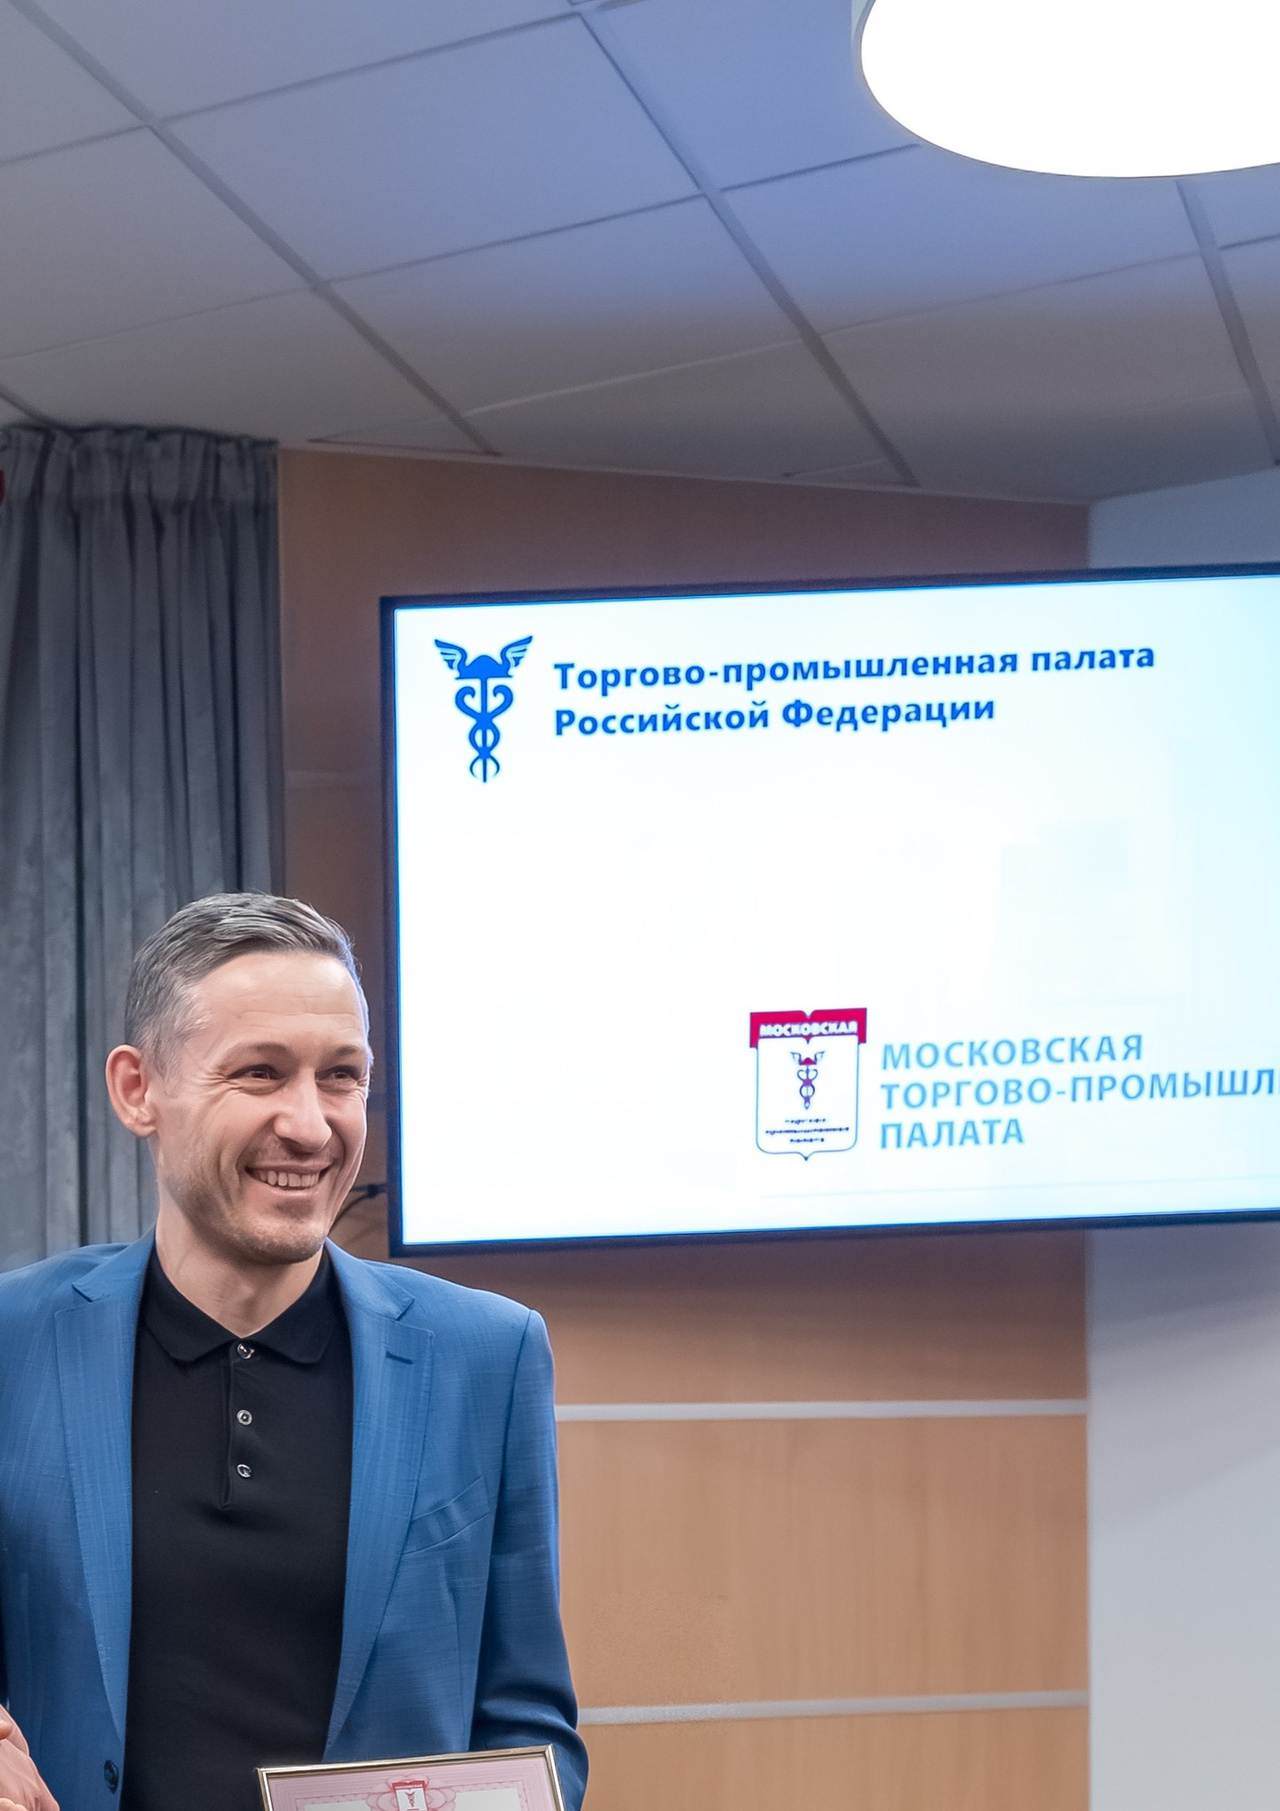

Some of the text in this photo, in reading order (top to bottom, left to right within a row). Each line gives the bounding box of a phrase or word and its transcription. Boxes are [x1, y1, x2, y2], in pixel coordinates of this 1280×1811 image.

[553, 647, 1155, 696] Торгово-промышленная палата
[555, 698, 995, 736] Российской Федерации
[882, 1033, 1143, 1071] МОСКОВСКАЯ
[880, 1068, 1280, 1110] ТОРГОВО-ПРОМЫШЛ
[880, 1118, 1024, 1150] ПАЛАТА
